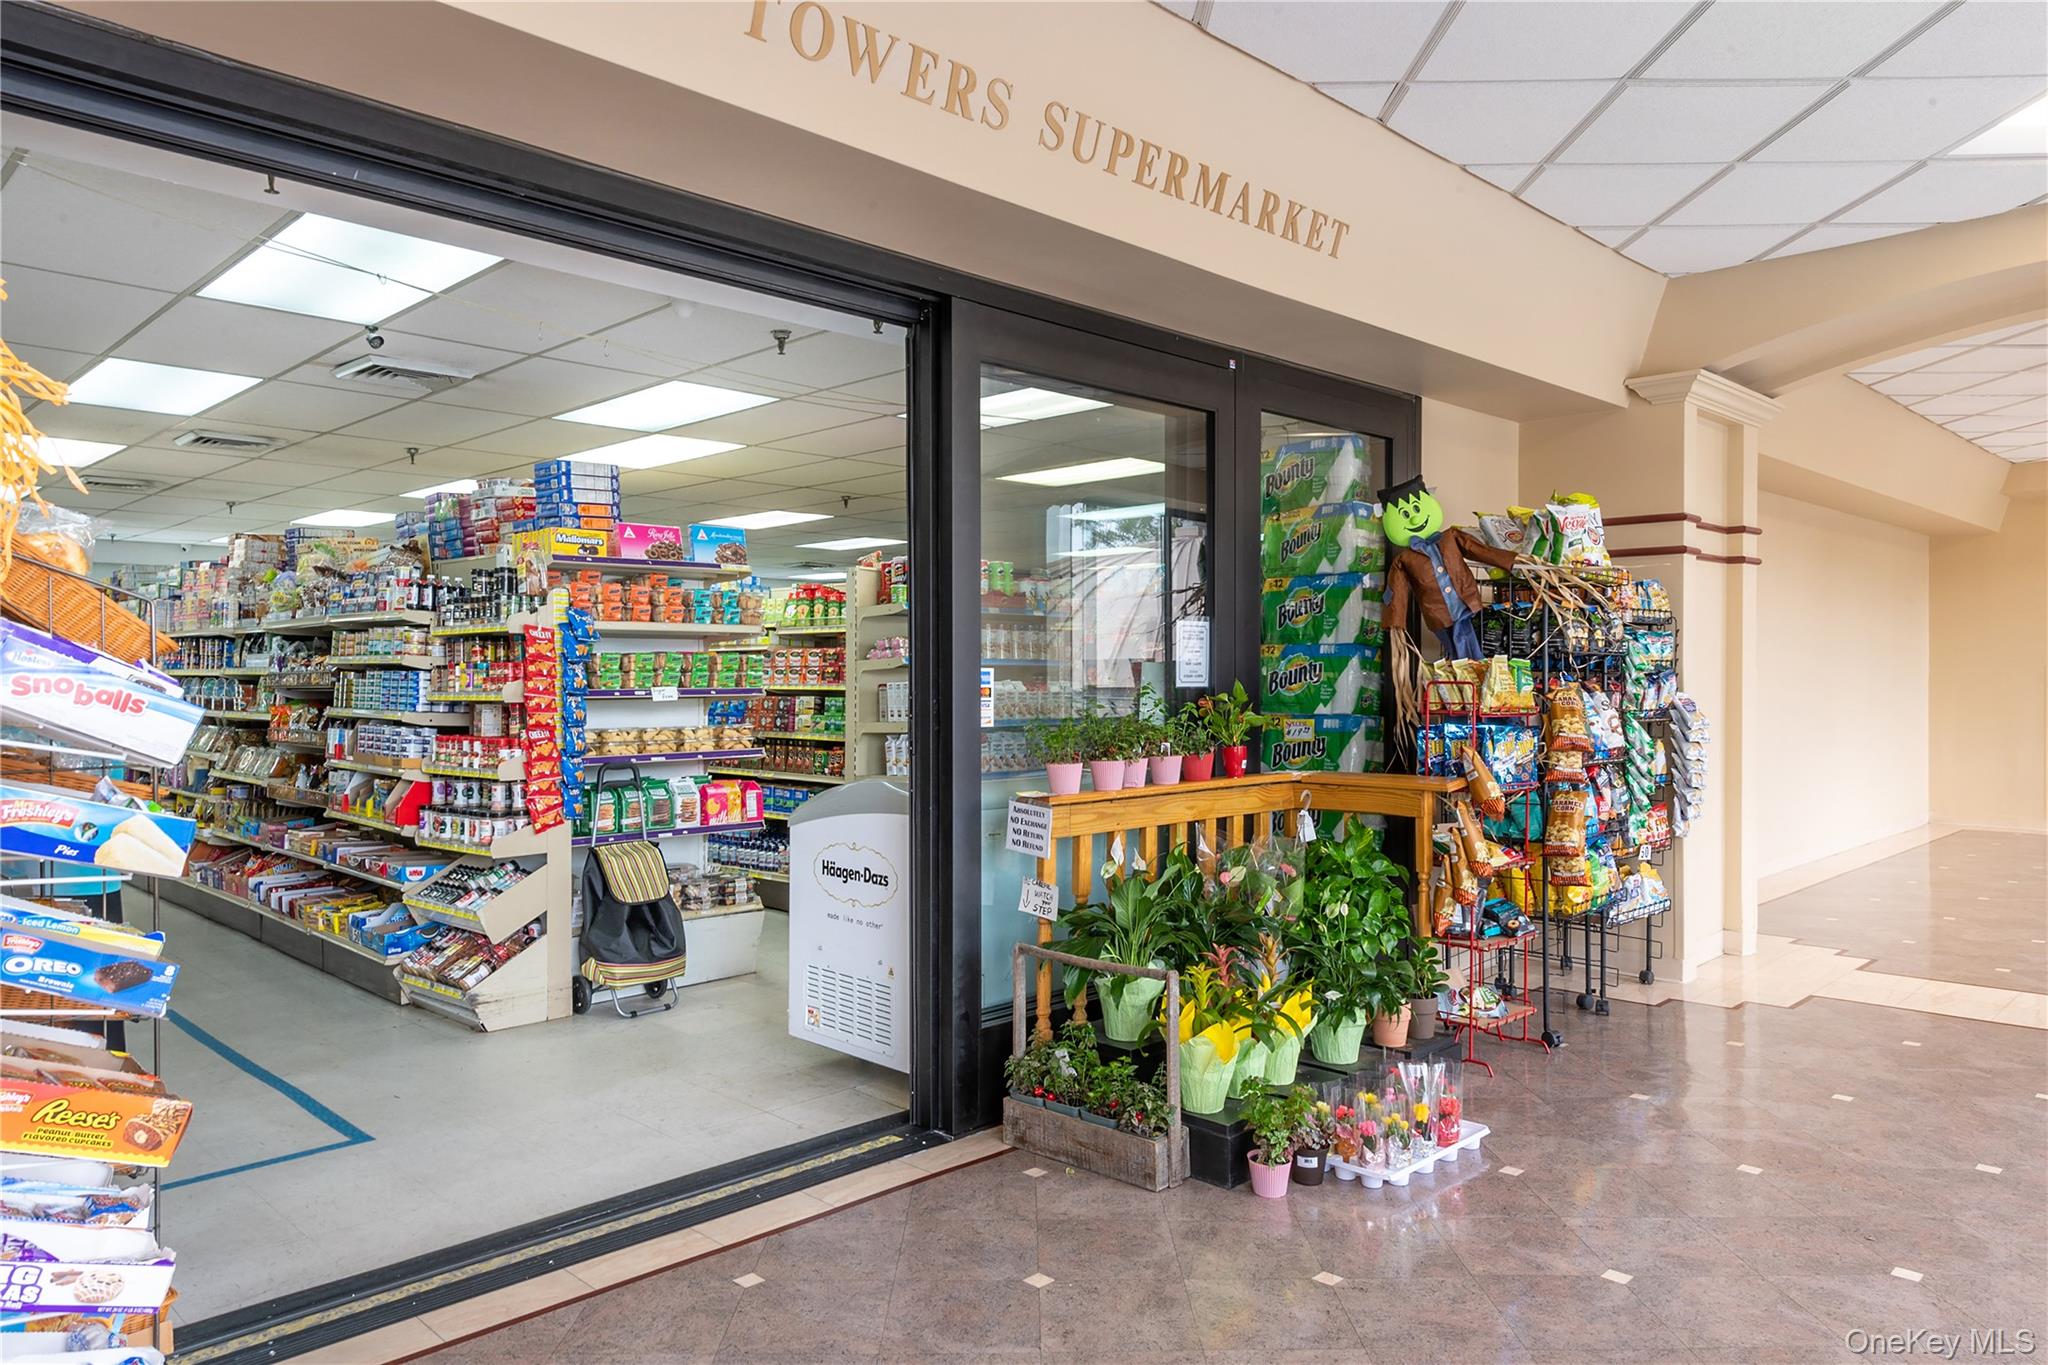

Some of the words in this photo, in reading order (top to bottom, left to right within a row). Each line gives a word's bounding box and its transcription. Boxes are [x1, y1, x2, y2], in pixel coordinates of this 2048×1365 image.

[743, 0, 1015, 131] TOWERS
[1038, 101, 1351, 260] SUPERMARKET
[1265, 456, 1315, 498] Bounty
[555, 534, 604, 545] Mallomars
[1281, 521, 1322, 564] Bounty
[1277, 592, 1325, 630] Bounty
[1268, 660, 1324, 697] Bounty
[1271, 736, 1327, 769] Bounty
[1010, 816, 1020, 825] NO
[1012, 827, 1022, 836] NO
[54, 844, 80, 857] Pies
[1011, 838, 1021, 848] NO
[822, 859, 889, 887] Häagen-Dazs
[1032, 904, 1053, 917] STEP
[22, 917, 46, 929] Iced
[47, 919, 80, 934] Lemon
[3, 956, 83, 977] OREO
[38, 975, 75, 990] Brownie
[32, 1098, 123, 1130] Reese's
